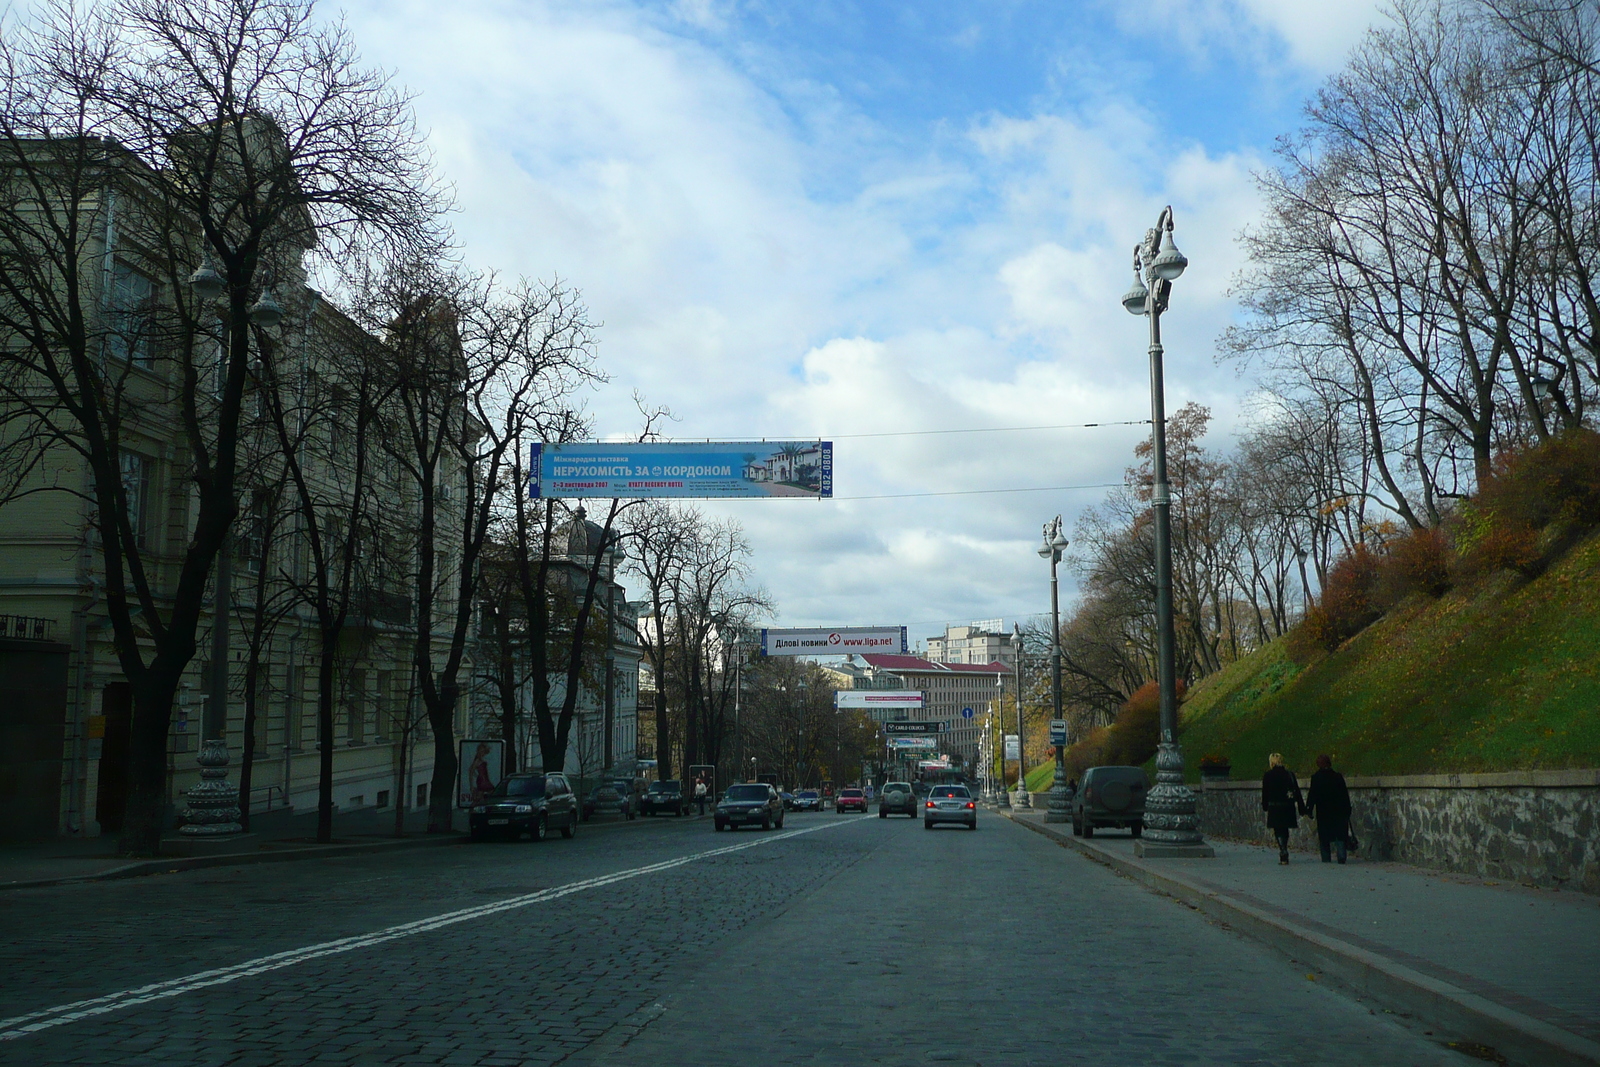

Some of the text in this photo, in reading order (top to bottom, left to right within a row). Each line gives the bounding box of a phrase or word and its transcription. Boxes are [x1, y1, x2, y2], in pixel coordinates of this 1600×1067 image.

[553, 455, 596, 463] Міжнародна
[553, 465, 731, 478] НЕРУХОМІСТЬ ЗА КОРДОНОМ
[823, 448, 831, 491] 482-0808
[775, 639, 800, 649] Ділові
[843, 637, 893, 647] www.liga.net
